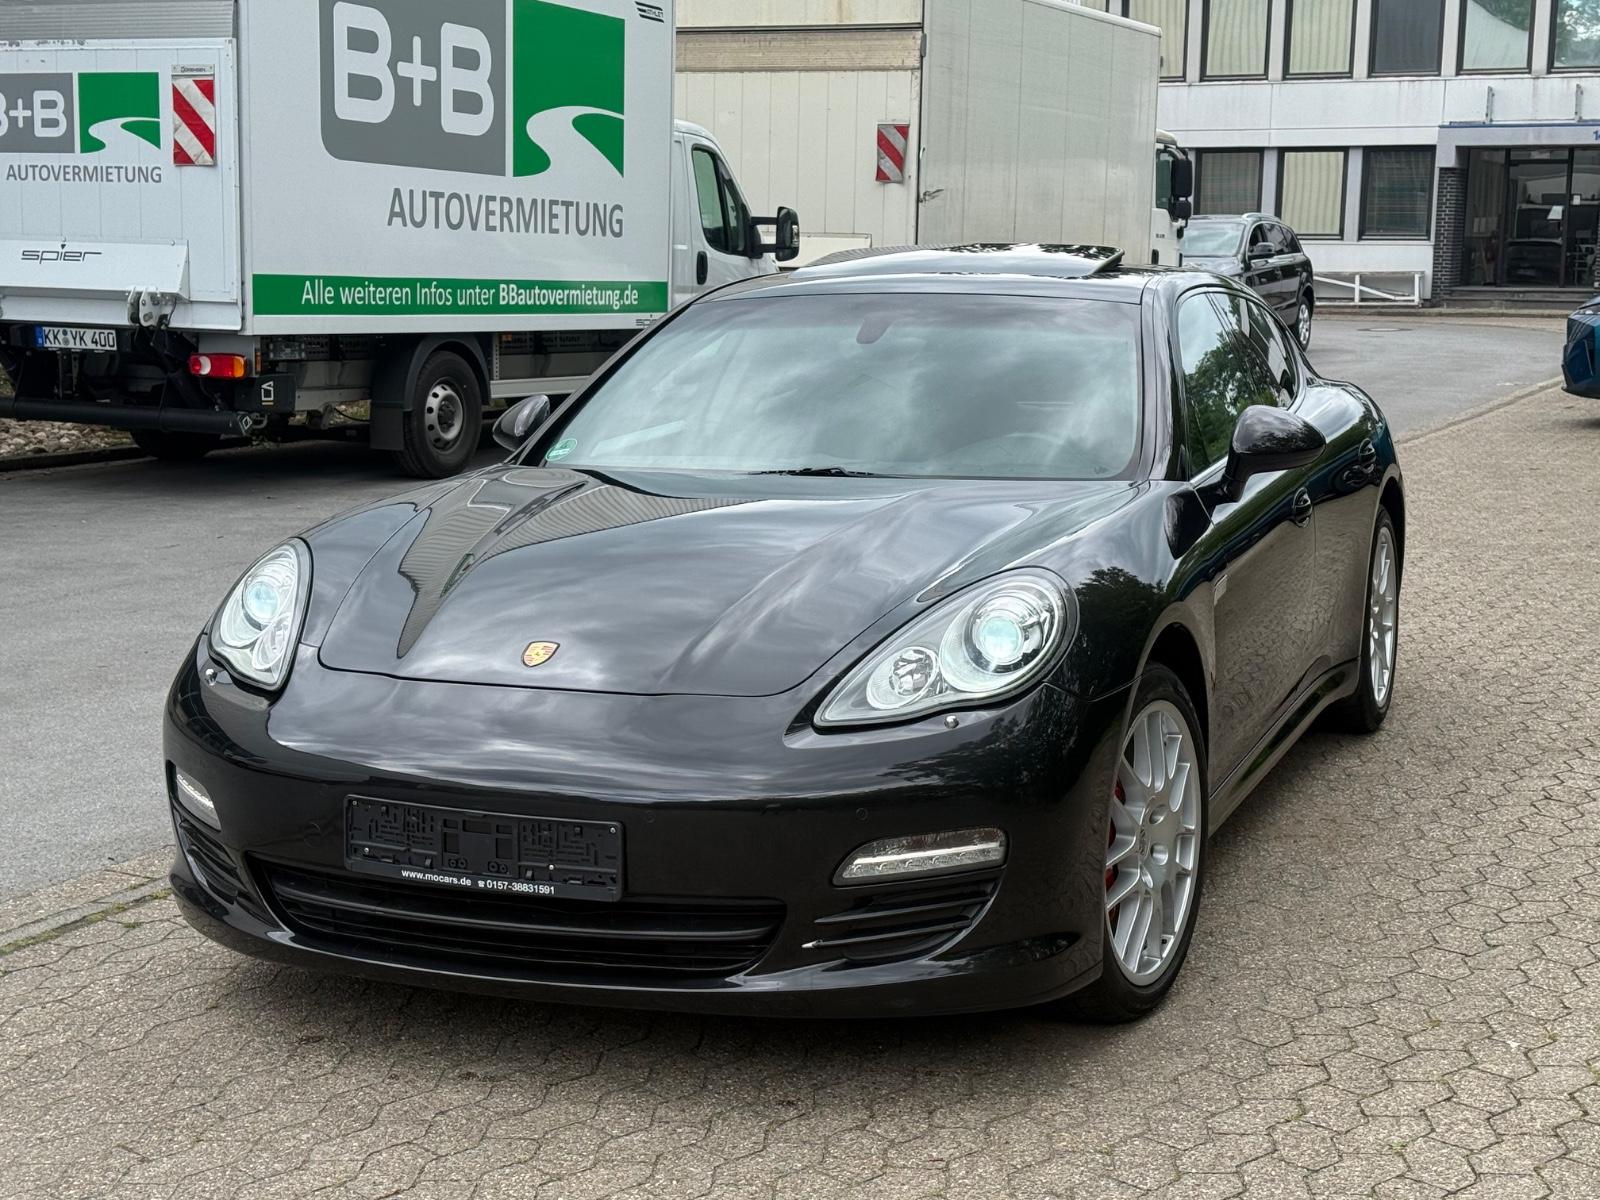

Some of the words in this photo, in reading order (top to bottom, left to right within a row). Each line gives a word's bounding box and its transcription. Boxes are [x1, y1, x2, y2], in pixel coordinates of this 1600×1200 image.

[333, 1, 494, 136] B+B
[0, 90, 67, 138] +B
[6, 164, 162, 184] AUTOVERMIETUNG
[387, 187, 624, 238] AUTOVERMIETUNG
[21, 243, 102, 264] spier
[302, 279, 335, 305] Alle
[339, 281, 412, 305] weiteren
[416, 281, 452, 306] Infos
[457, 284, 496, 306] unter
[499, 284, 639, 310] BBautovermietung.de
[43, 328, 61, 345] KK
[70, 331, 88, 347] YK
[91, 331, 116, 348] 400
[401, 869, 472, 886] www.mocars.de
[486, 879, 555, 895] 0157-38831591
